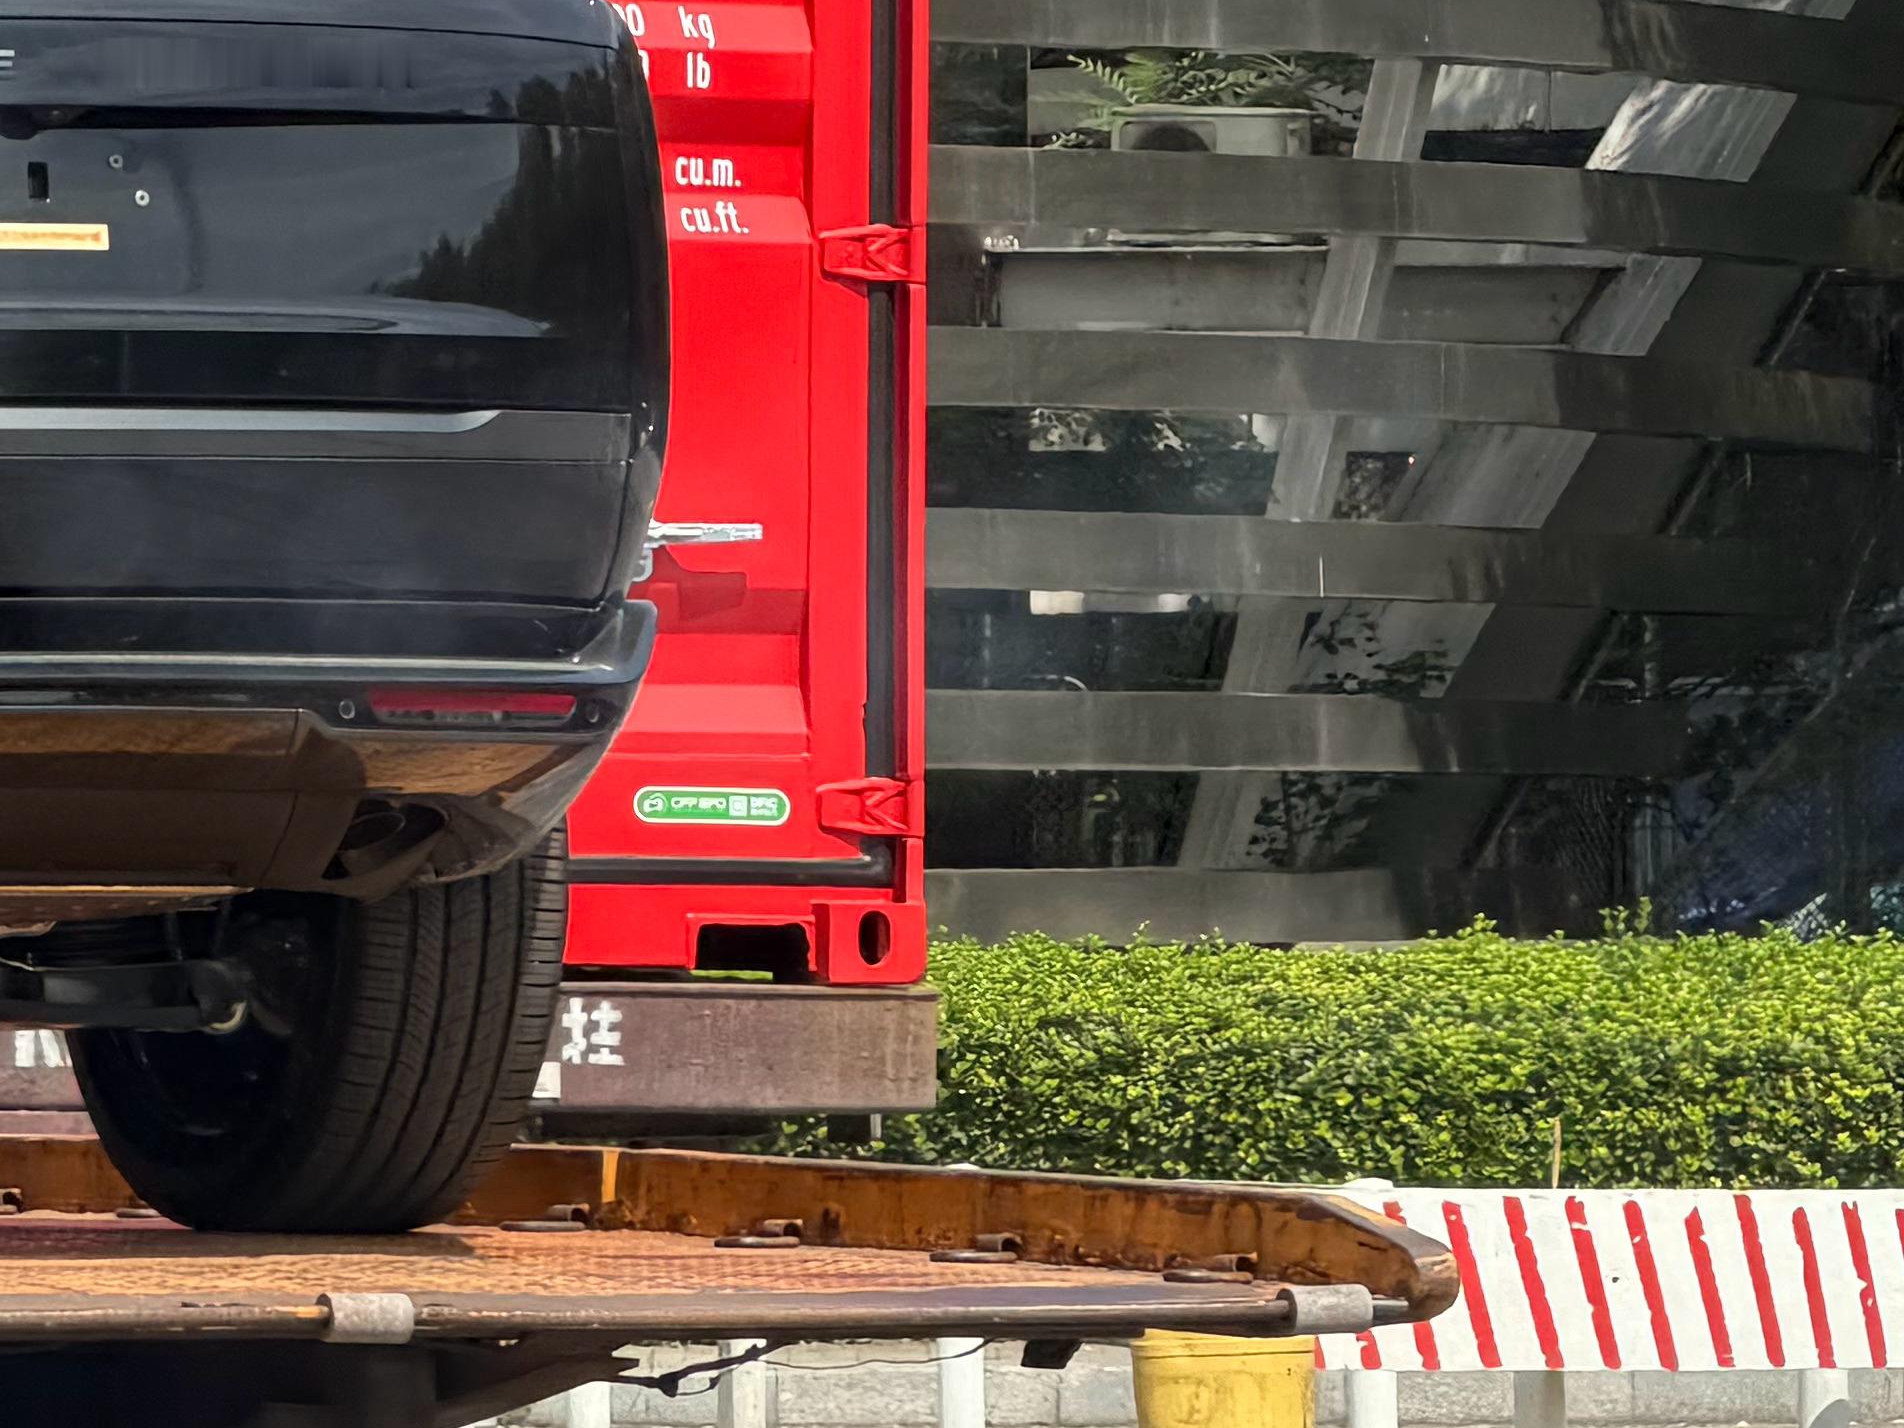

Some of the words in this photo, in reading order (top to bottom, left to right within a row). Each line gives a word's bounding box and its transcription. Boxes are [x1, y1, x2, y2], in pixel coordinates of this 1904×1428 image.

[677, 5, 716, 50] kg
[686, 51, 711, 89] lb
[675, 156, 742, 188] cu.m.
[561, 997, 626, 1066] 挂
